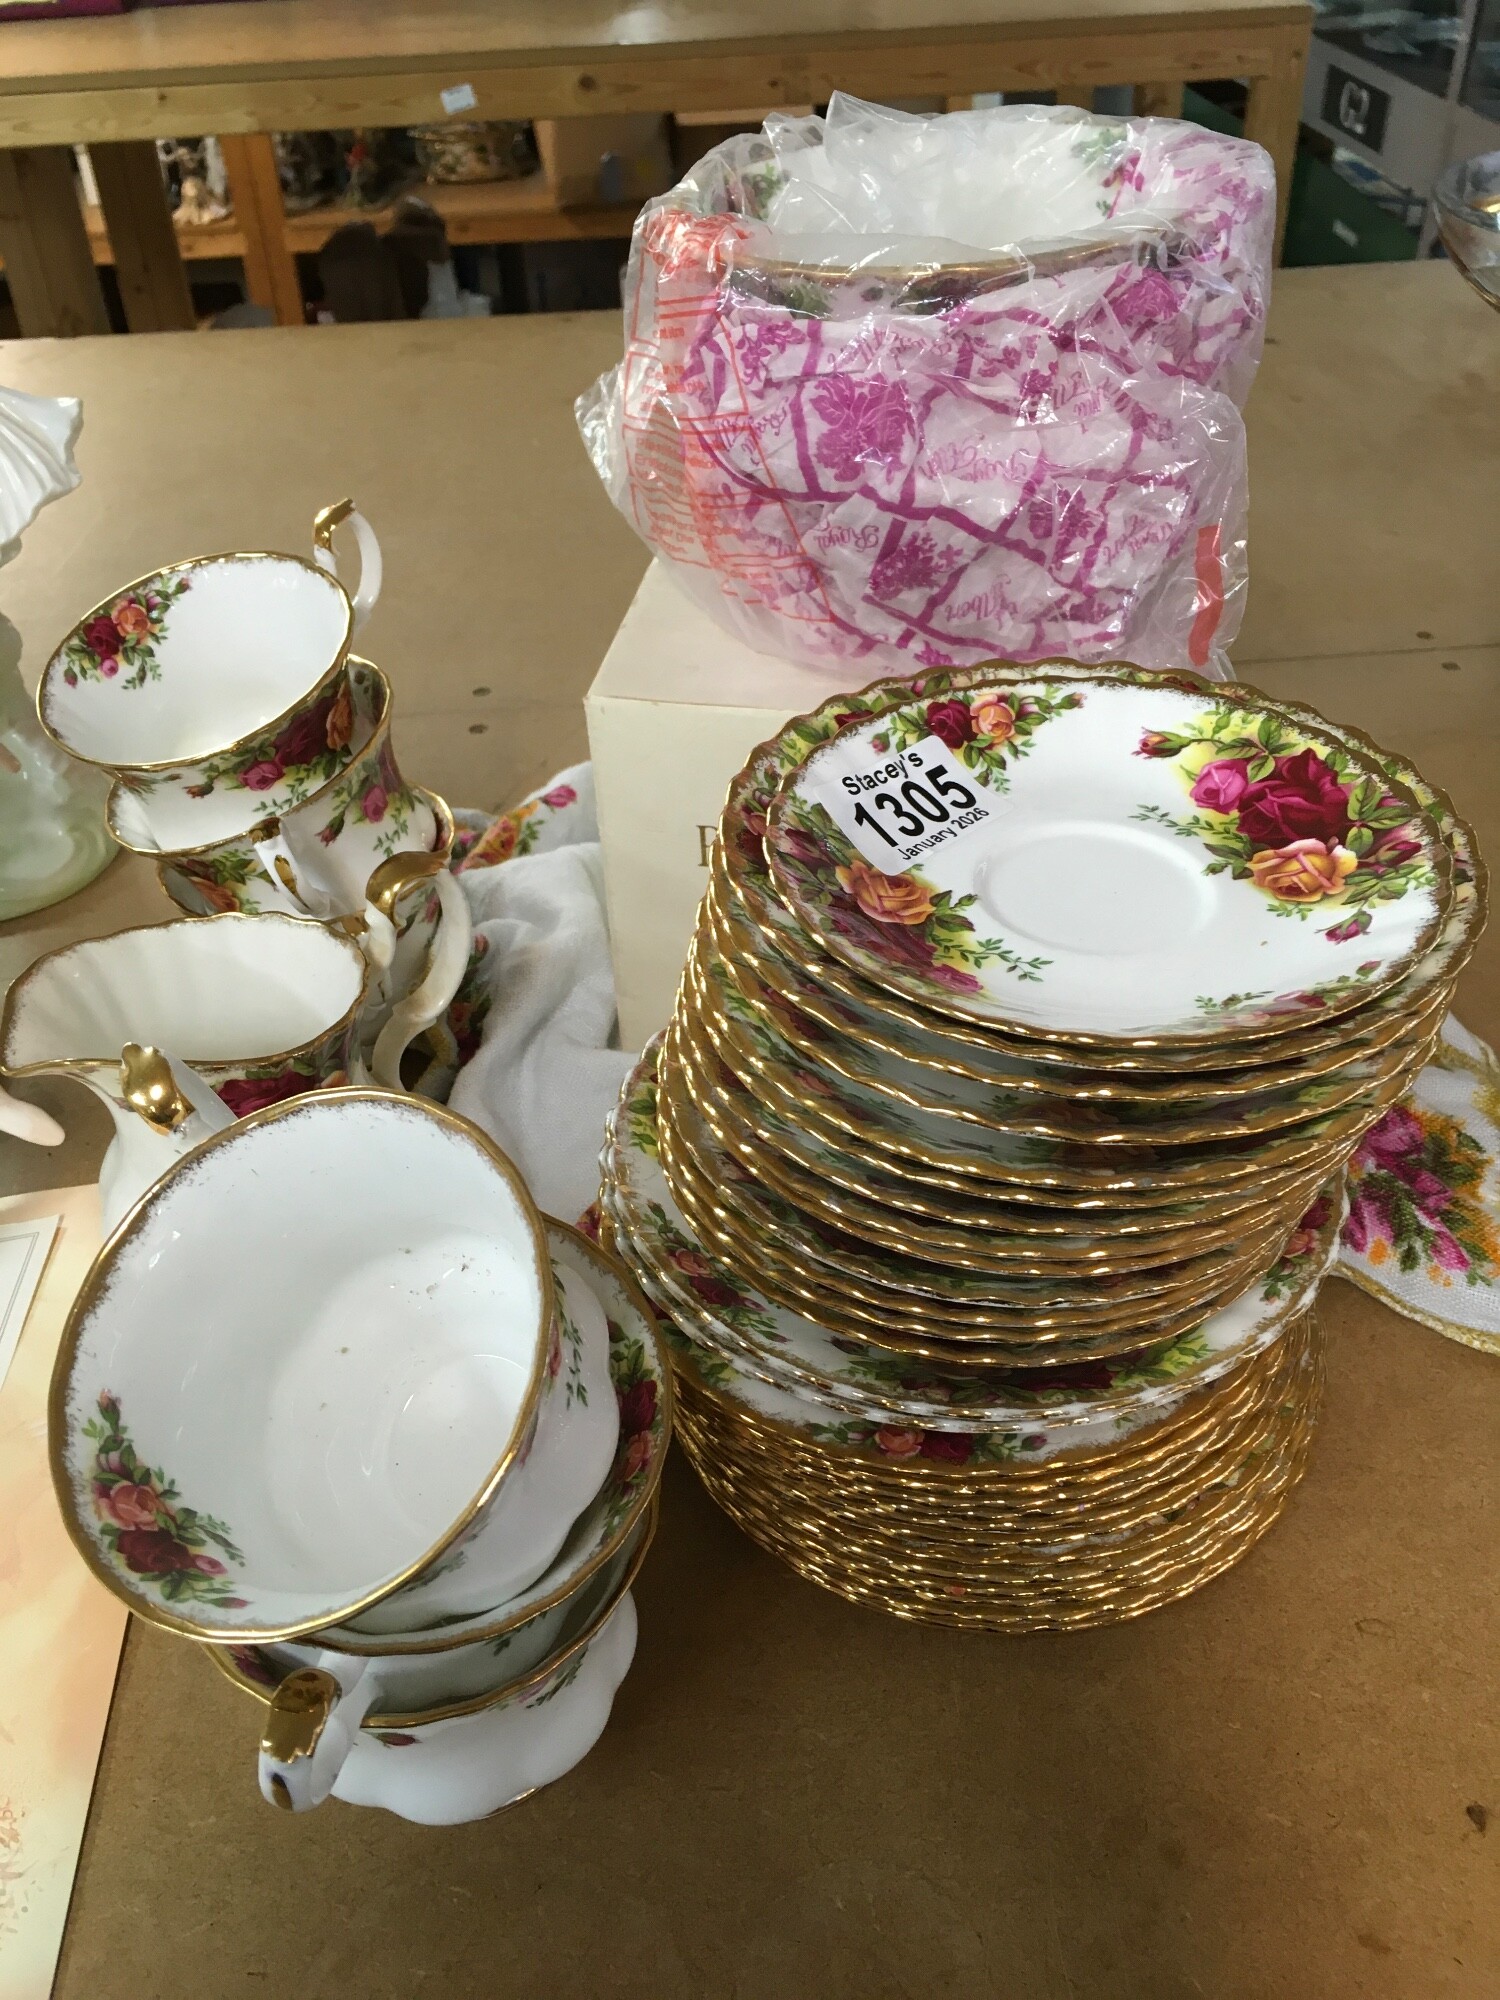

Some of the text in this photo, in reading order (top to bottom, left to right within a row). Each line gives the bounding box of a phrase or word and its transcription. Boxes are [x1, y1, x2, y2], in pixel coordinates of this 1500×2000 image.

[813, 524, 880, 556] Royal
[842, 752, 924, 796] Stacey's
[854, 764, 977, 848] 1305
[897, 807, 990, 861] January 2026
